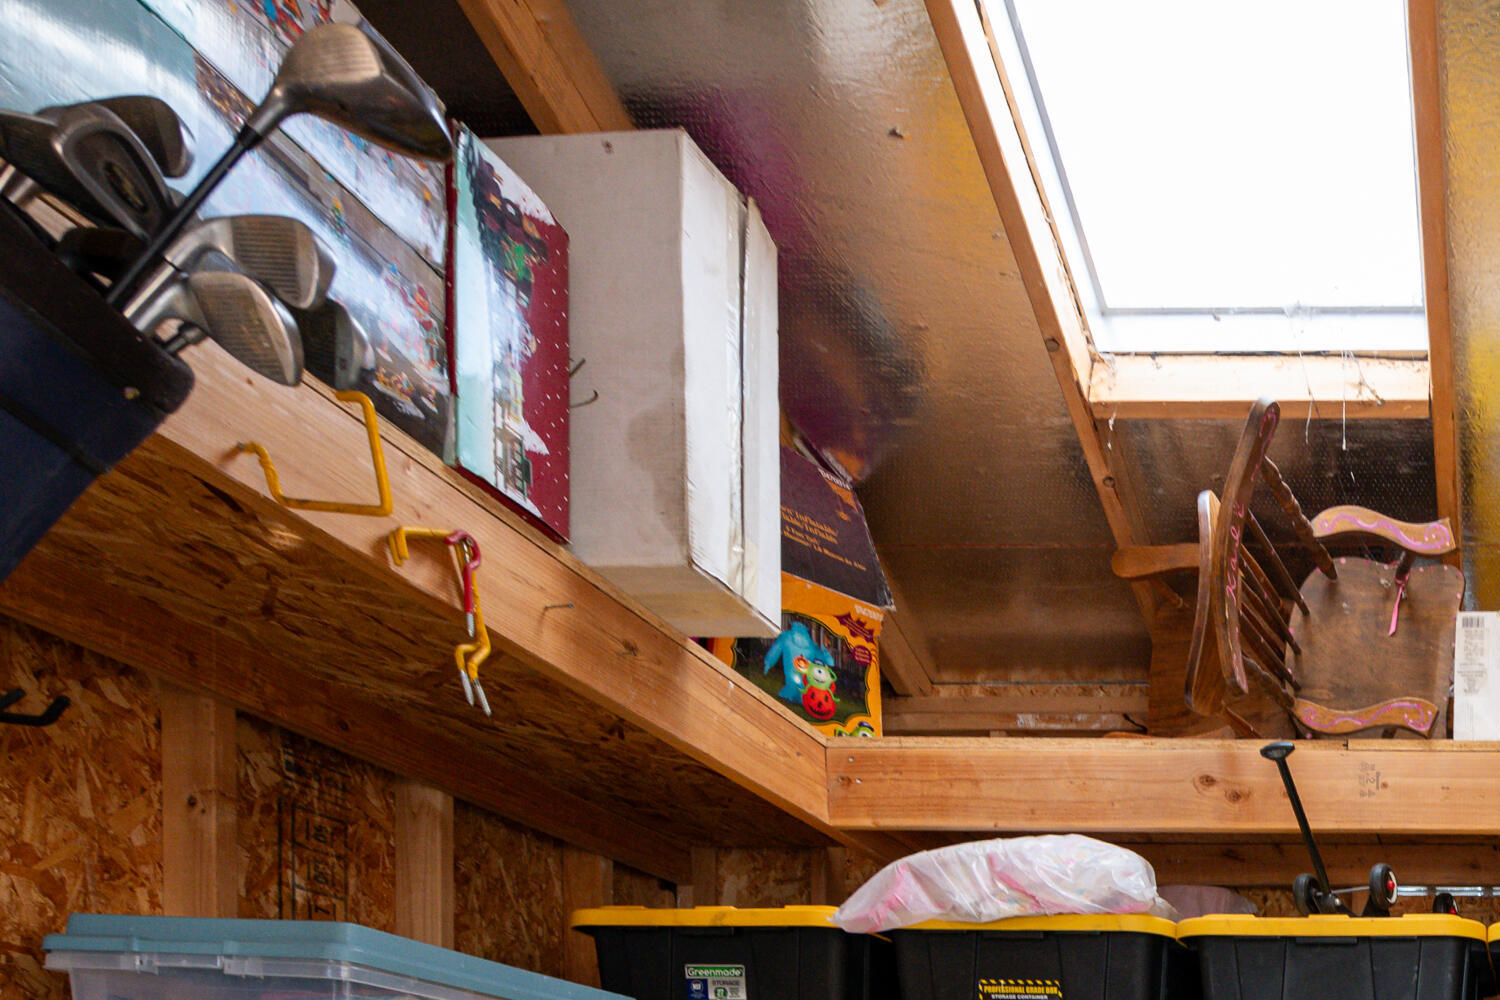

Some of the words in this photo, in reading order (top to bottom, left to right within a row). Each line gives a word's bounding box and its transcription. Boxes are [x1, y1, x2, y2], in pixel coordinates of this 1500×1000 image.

[687, 967, 741, 977] Greenmade
[983, 985, 1025, 994] PROFESSIONAL
[1026, 986, 1045, 994] GRADE
[1046, 986, 1058, 994] BOX
